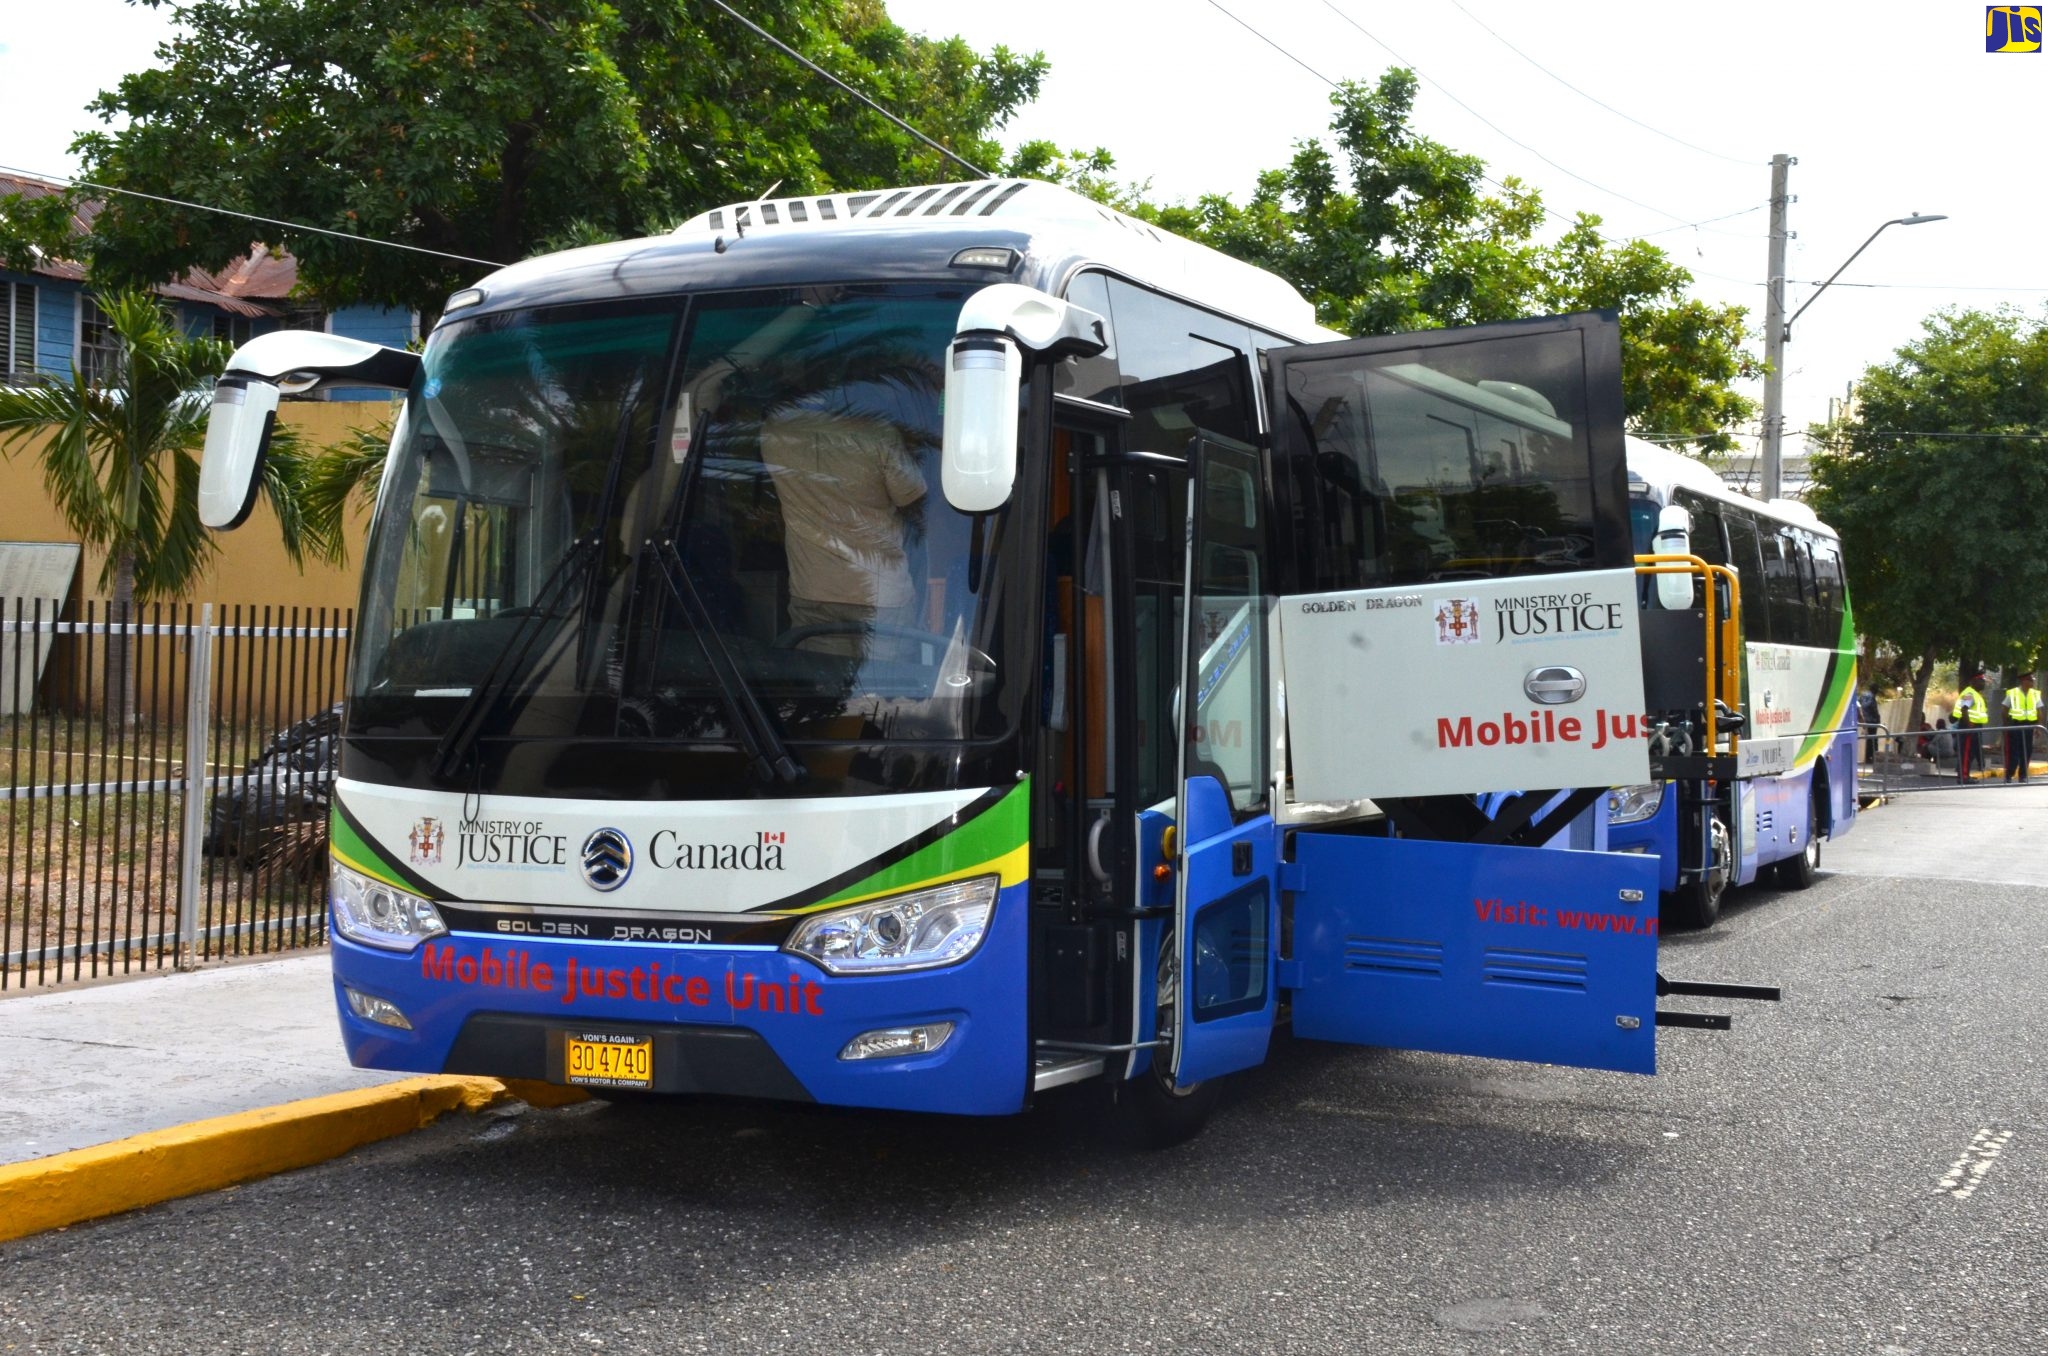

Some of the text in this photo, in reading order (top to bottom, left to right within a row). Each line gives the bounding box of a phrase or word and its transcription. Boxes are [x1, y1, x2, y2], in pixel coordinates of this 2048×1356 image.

[1302, 595, 1423, 614] GOLDEN DRAGON
[1494, 592, 1592, 611] MINISTRY OF
[1496, 603, 1623, 645] JUSTICE
[1437, 710, 1582, 749] Mobile
[459, 820, 543, 835] MINISTRY OF
[455, 833, 567, 870] JUSTICE
[649, 829, 786, 871] Canada
[1474, 898, 1548, 927] Visit:
[497, 919, 713, 944] GOLDEN DRAGON
[422, 943, 824, 1016] Mobile Justice Unit
[582, 1033, 635, 1044] VON'S AGAIN
[572, 1044, 647, 1074] 30 4740
[589, 1077, 611, 1085] MOTOR
[617, 1079, 648, 1087] COMPANY
